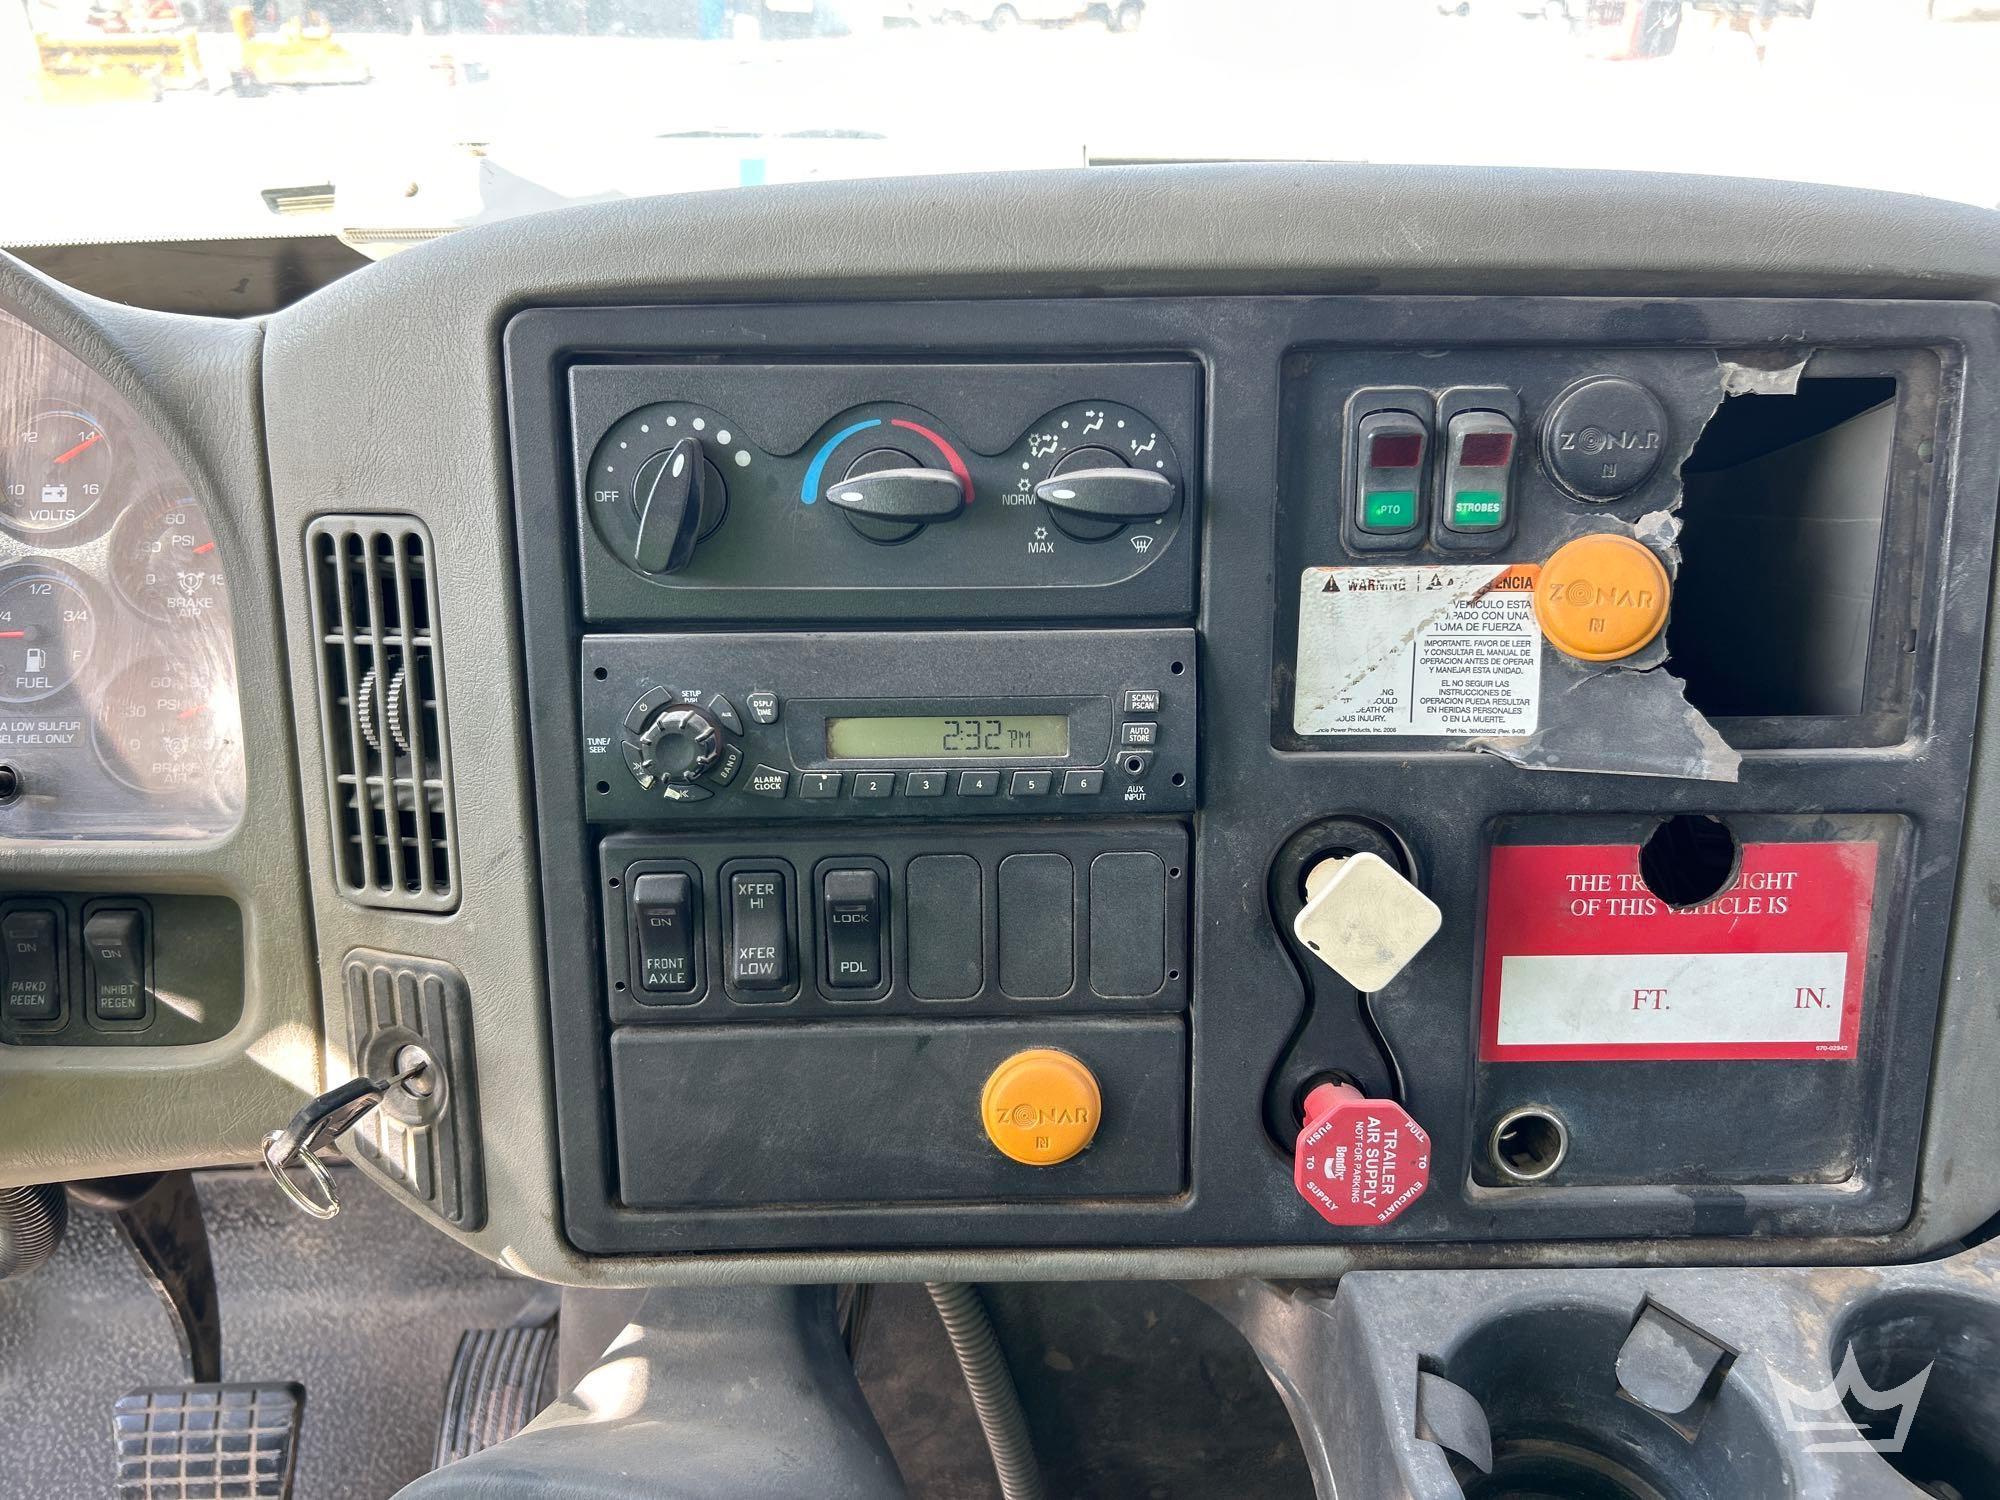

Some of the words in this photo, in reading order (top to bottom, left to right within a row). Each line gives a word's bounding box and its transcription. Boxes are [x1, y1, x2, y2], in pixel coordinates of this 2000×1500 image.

[78, 431, 96, 441] 14
[1560, 427, 1660, 456] ZONAR
[7, 484, 24, 495] 10
[82, 484, 99, 494] 16
[594, 491, 619, 503] OFF
[1002, 494, 1036, 505] NORM
[1380, 504, 1401, 515] PTO
[1455, 502, 1500, 513] STROBES
[29, 510, 75, 521] VOLTS
[172, 535, 195, 546] PSI
[1028, 542, 1054, 553] MAX
[210, 574, 225, 585] 15
[30, 584, 52, 595] 1/2
[1549, 579, 1654, 609] ZONAR
[167, 597, 214, 608] BRAKE
[1507, 600, 1532, 609] ESTA
[0, 611, 12, 622] /4
[63, 610, 88, 622] 3/4
[178, 608, 201, 617] AIR
[1481, 611, 1504, 620] CON
[1507, 611, 1529, 620] UNA
[1466, 622, 1480, 631] DE
[1482, 622, 1523, 631] FUERZA
[73, 651, 81, 661] F
[16, 678, 53, 689] FUEL
[1131, 694, 1155, 702] SCAN/
[1439, 706, 1471, 714] HERIDAS
[11, 721, 35, 731] LOW
[38, 721, 81, 731] SULFUR
[1129, 727, 1150, 735] AUTO
[16, 734, 43, 744] FUEL
[45, 734, 74, 744] ONLY
[943, 720, 1001, 750] 2:32
[1007, 729, 1032, 749] PM
[1129, 734, 1150, 742] STORE
[587, 738, 611, 746] TUNE/
[589, 746, 607, 754] SEEK
[720, 754, 737, 778] BAND
[753, 775, 782, 784] ALARM
[923, 780, 929, 790] 3
[976, 779, 983, 789] 4
[1028, 780, 1035, 789] 5
[1080, 779, 1087, 788] 6
[754, 783, 781, 791] CLOCK
[818, 782, 824, 791] 1
[870, 782, 877, 791] 2
[1127, 785, 1145, 793] AUX
[1124, 793, 1147, 801] INPUT
[1566, 873, 1611, 892] THE
[738, 883, 775, 895] XFER
[750, 897, 764, 909] HI
[1570, 898, 1601, 917] OF
[1605, 898, 1656, 916] THIS
[1767, 896, 1788, 915] IS
[650, 917, 672, 927] ON
[833, 914, 869, 923] LOCK
[17, 943, 37, 953] ON
[739, 947, 775, 959] XFER
[101, 949, 122, 959] ON
[647, 957, 684, 969] FRONT
[840, 961, 868, 973] PDL
[740, 963, 774, 975] LOW
[649, 973, 685, 984] AXLE
[11, 981, 47, 992] PARKD
[101, 984, 134, 994] INHIBT
[10, 995, 45, 1005] REGEN
[101, 998, 135, 1008] REGEN
[1631, 988, 1671, 1011] FT.
[1794, 987, 1831, 1009] IN.
[996, 1103, 1089, 1130] ZONAR
[1306, 1122, 1334, 1146] PUSH
[1354, 1121, 1364, 1140] NOT
[1366, 1115, 1381, 1143] AIR
[1404, 1120, 1425, 1143] PULL
[1353, 1142, 1363, 1161] FOR
[1306, 1155, 1315, 1170] TO
[1381, 1128, 1398, 1195] TRAILER
[1418, 1155, 1427, 1170] TO
[1351, 1163, 1362, 1203] PARKING
[1363, 1148, 1380, 1208] SUPPLY
[1306, 1181, 1339, 1211] SUPPLY
[1377, 1181, 1423, 1222] EVACUATE
